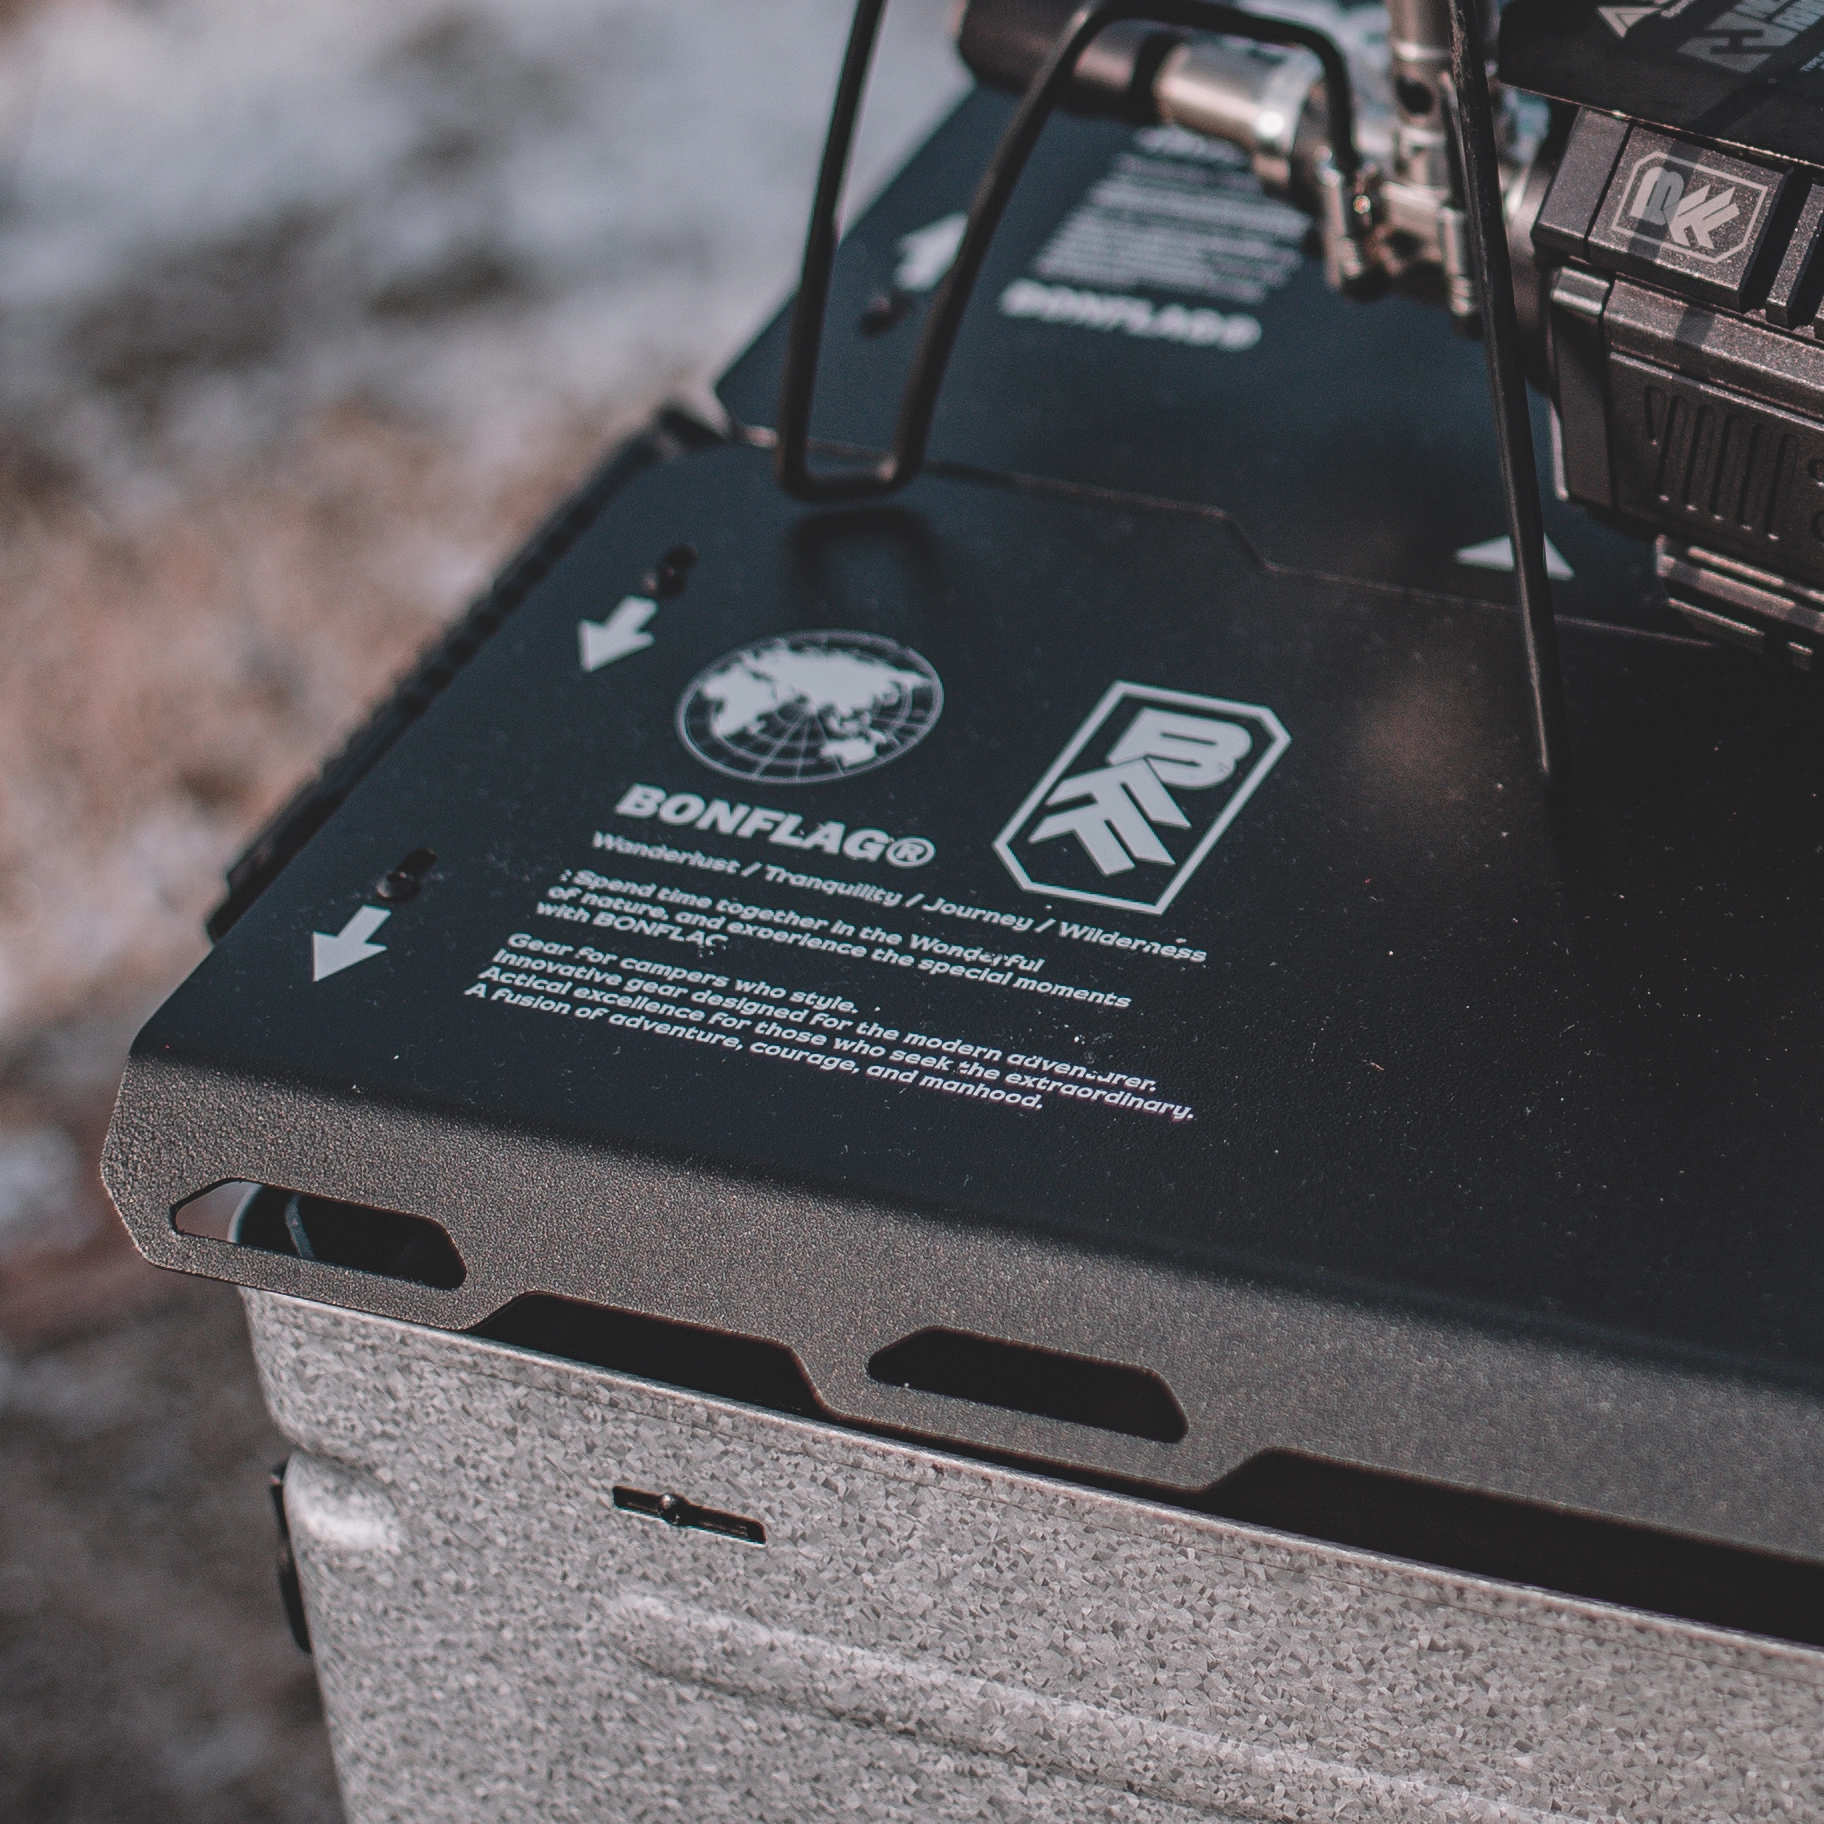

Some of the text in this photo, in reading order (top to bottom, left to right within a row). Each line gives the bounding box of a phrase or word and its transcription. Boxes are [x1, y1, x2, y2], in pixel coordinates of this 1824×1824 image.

[537, 902, 590, 923] with
[548, 886, 582, 900] of
[675, 912, 726, 930] and
[727, 922, 867, 957] experience
[871, 948, 915, 966] the
[918, 959, 1013, 985] special
[1013, 977, 1132, 1008] moments
[593, 831, 740, 874] Wanderlust
[765, 864, 903, 907] Tranquility
[922, 898, 1034, 931] Journey
[1059, 921, 1207, 962] Wilderness
[657, 887, 712, 909] time
[716, 899, 829, 930] together
[830, 920, 855, 936] in
[859, 927, 902, 945] the
[493, 948, 622, 986] Innovative
[623, 978, 688, 998] gear
[691, 990, 809, 1022] designed
[809, 1013, 853, 1030] for
[856, 1022, 899, 1040] the
[903, 1033, 1002, 1061] modern
[508, 933, 574, 956] Gear
[620, 958, 729, 987] campers
[735, 980, 786, 998] who
[789, 992, 858, 1014] style.
[464, 983, 1042, 1109] A fusion of adventure, courage, and manhood.
[478, 966, 573, 995] Actical
[573, 988, 705, 1021] excellence
[708, 1012, 752, 1030] for
[754, 1021, 827, 1046] those
[833, 1038, 886, 1057] who
[889, 1050, 954, 1071] seek
[1005, 1073, 1194, 1120] extraordinary.
